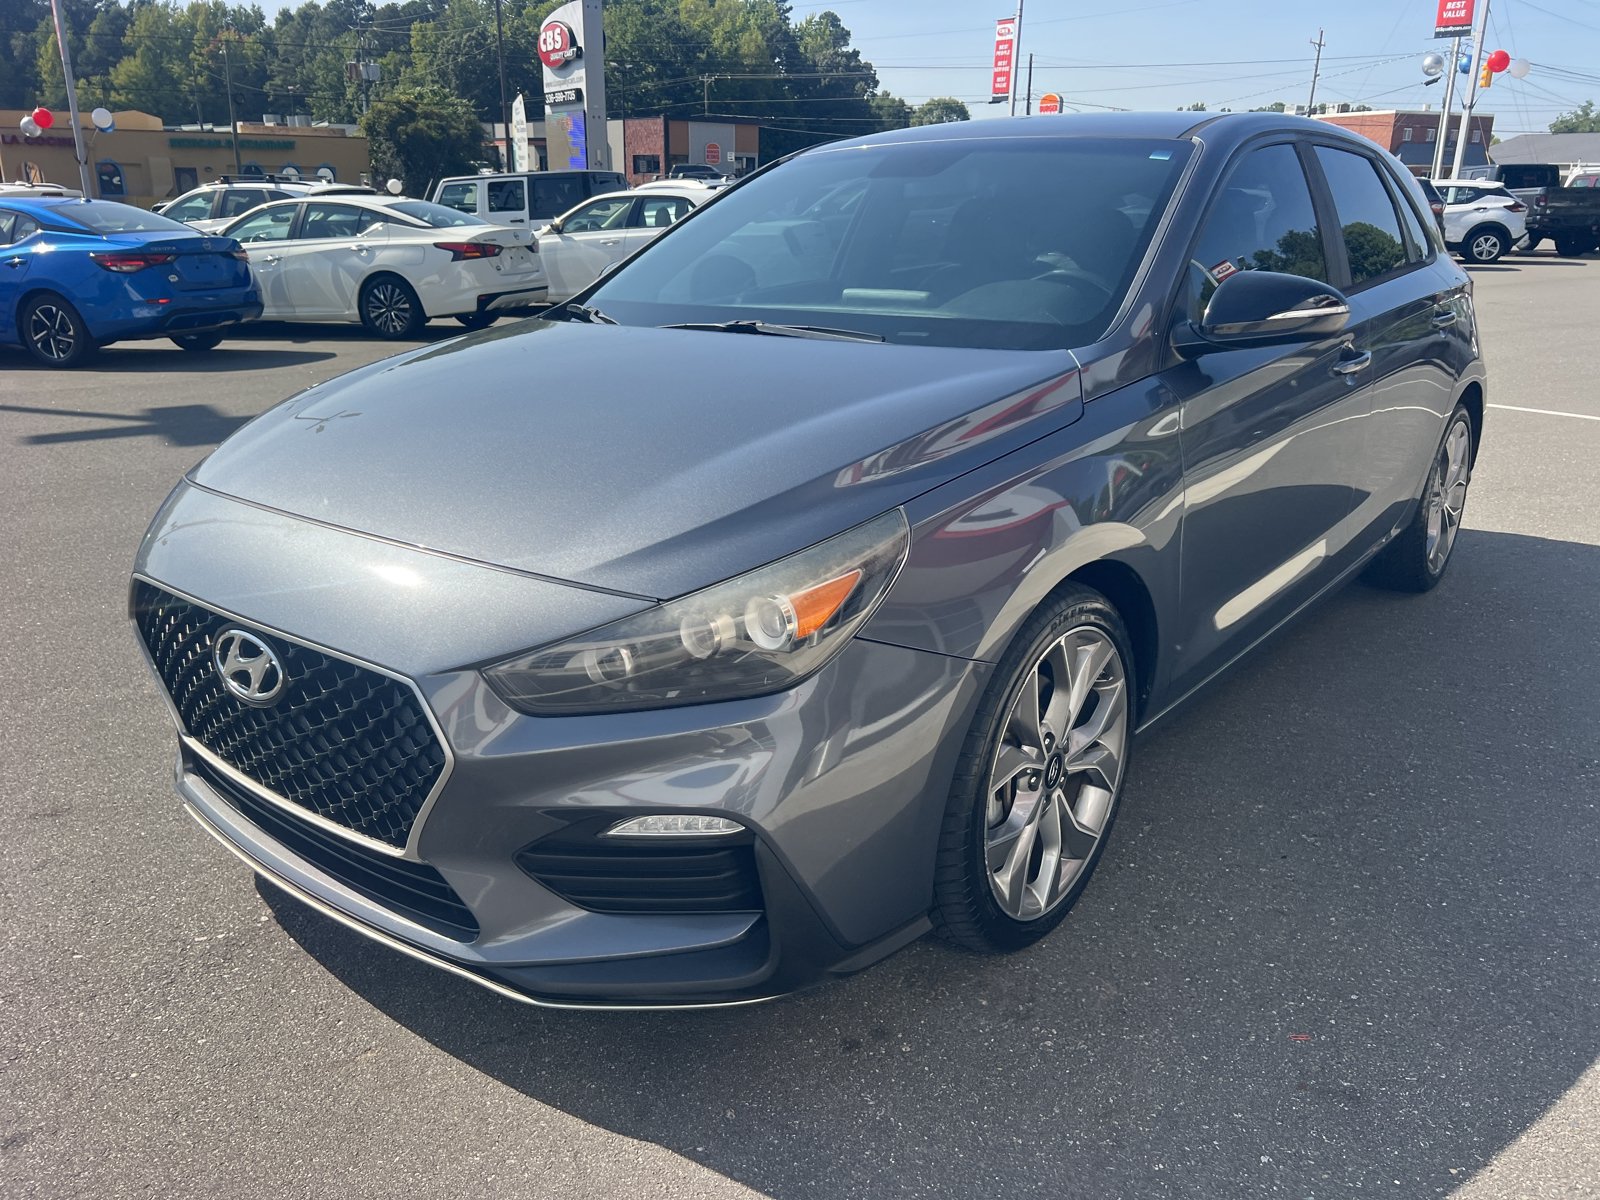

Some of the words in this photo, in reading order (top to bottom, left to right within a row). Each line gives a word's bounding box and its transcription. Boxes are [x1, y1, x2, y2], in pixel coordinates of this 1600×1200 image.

[1446, 1, 1466, 9] BEST
[1443, 10, 1467, 18] VALUE
[540, 27, 563, 53] CBS
